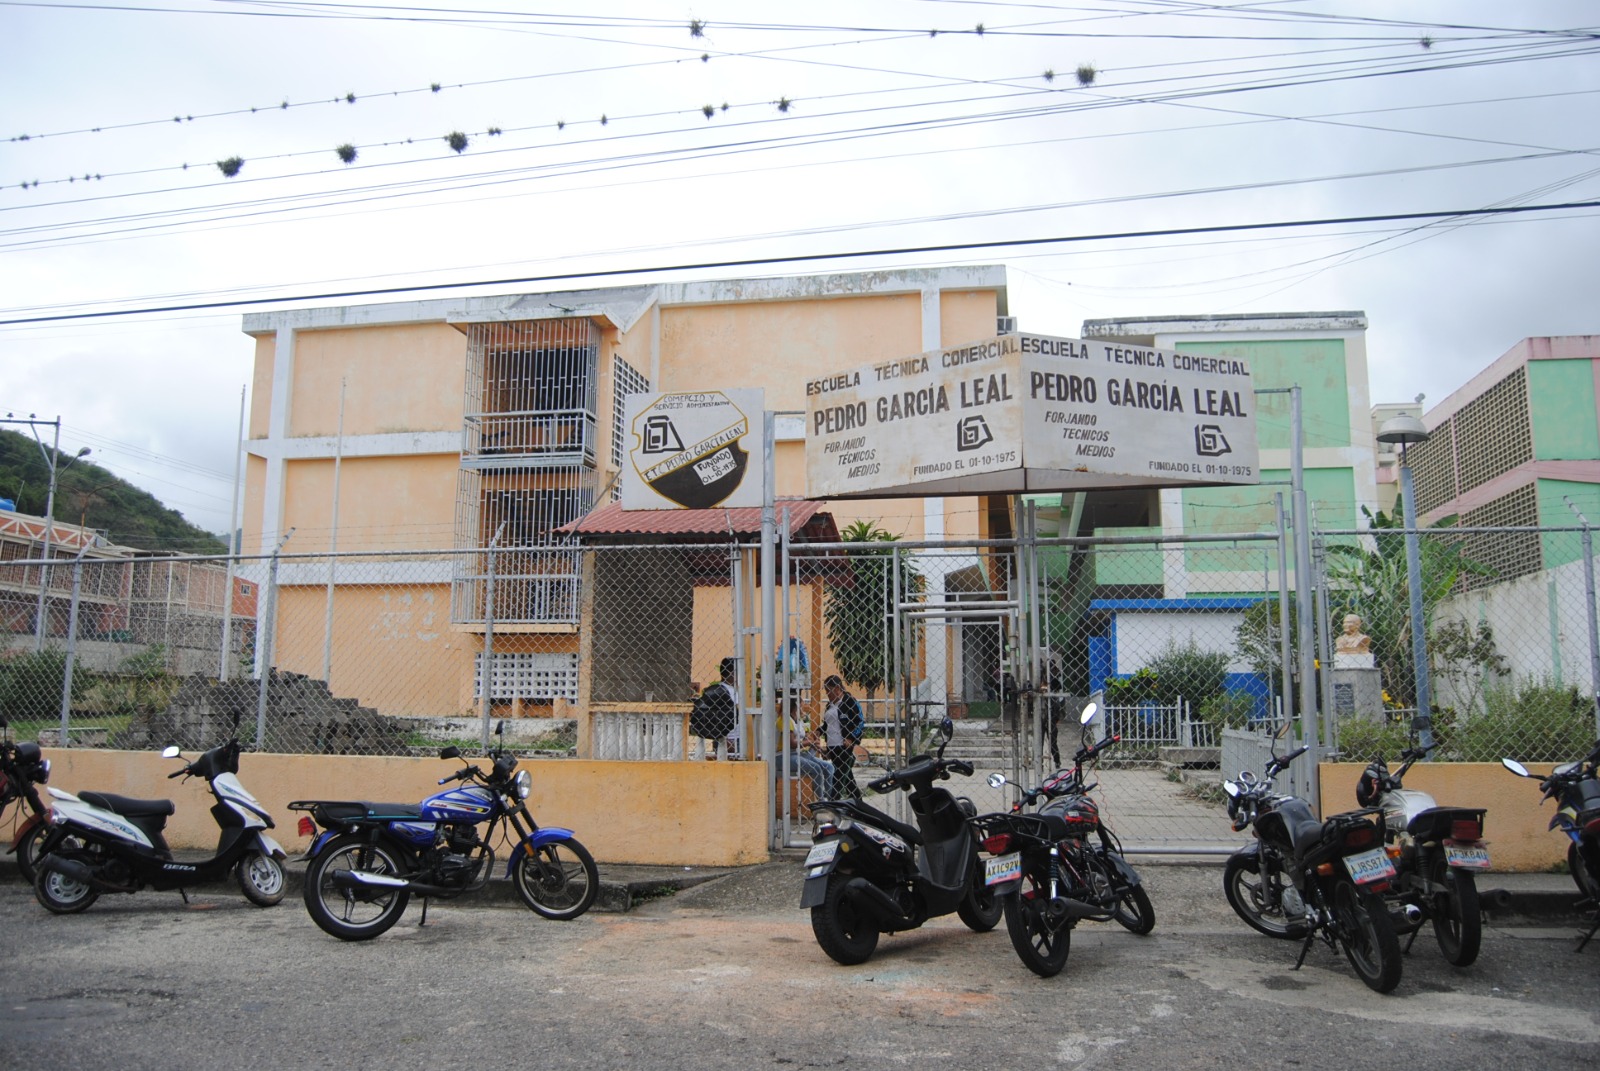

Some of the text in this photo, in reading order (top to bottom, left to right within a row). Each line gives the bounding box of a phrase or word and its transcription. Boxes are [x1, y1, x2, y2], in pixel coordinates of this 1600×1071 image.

[1021, 337, 1089, 360] ESCUELA
[1173, 354, 1250, 376] COMERCIAL
[806, 371, 861, 397] ESCUELA
[941, 338, 1018, 369] COMERCIAL
[1030, 370, 1247, 417] PEDRO GARCÍA LEAL
[813, 373, 1013, 436] PEDRO GARCÍA LEAL
[1044, 411, 1097, 426] FORJANDO
[1063, 427, 1110, 442] TECNICOS
[824, 436, 866, 454] FORJANDO
[1075, 444, 1116, 458] MEDIOS
[665, 452, 692, 471] PEDRO
[697, 451, 731, 471] FUNDADO
[913, 451, 1016, 476] FUNDADO EL 01-10-1975
[1149, 461, 1251, 476] FUNDADO EL 01-10-1975
[847, 462, 881, 479] MEDIOS
[163, 863, 197, 872] BERA
